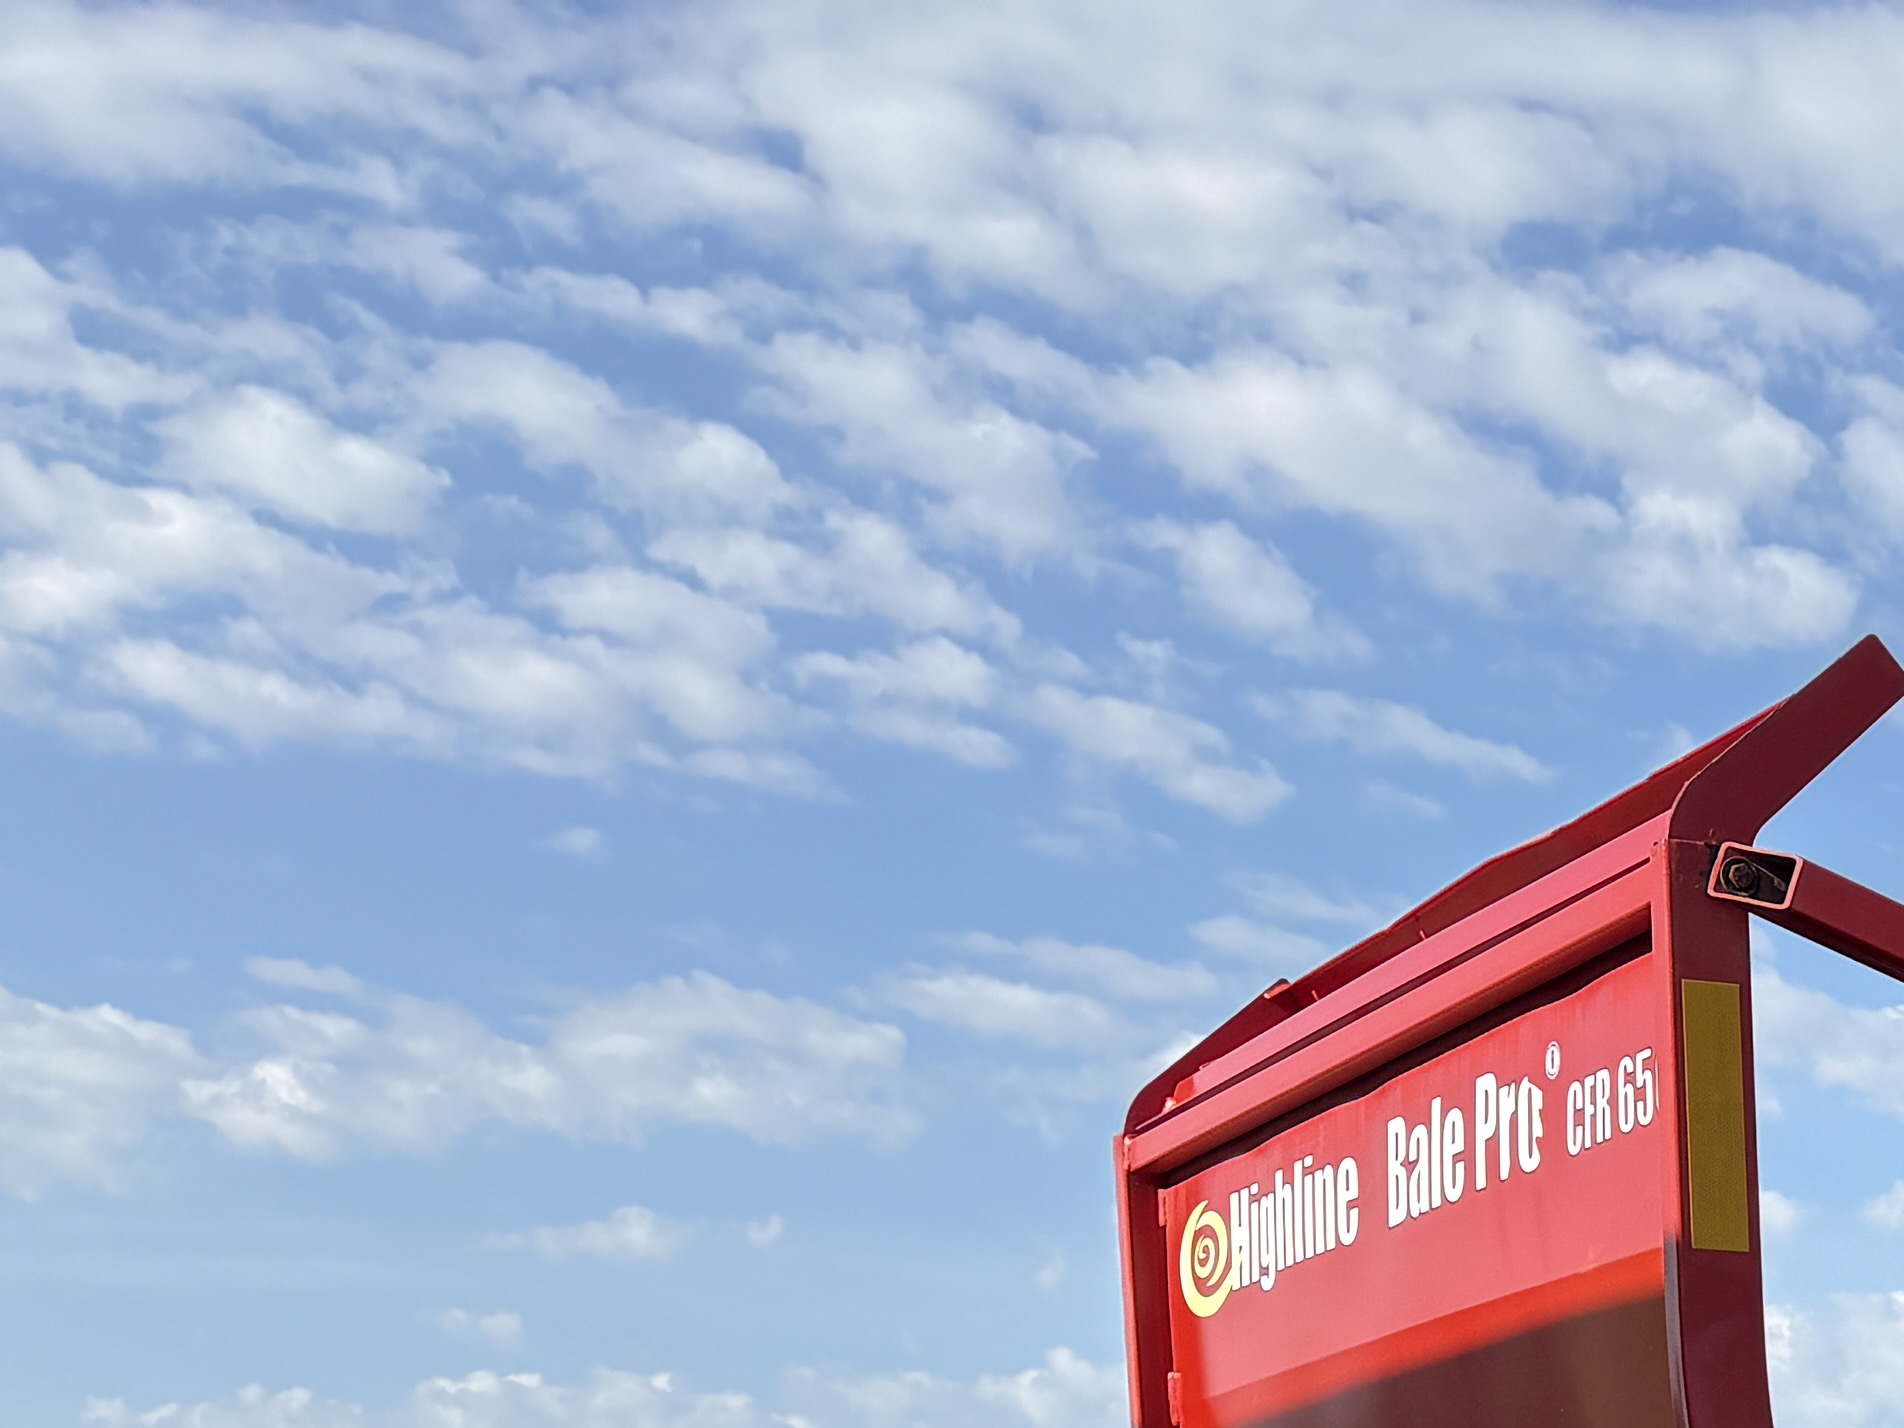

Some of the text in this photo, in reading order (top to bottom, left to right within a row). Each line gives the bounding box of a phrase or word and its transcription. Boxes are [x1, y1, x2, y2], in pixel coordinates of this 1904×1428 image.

[1229, 1154, 1360, 1292] Highline
[1386, 1095, 1466, 1230] Bale
[1475, 1071, 1545, 1192] Pro
[1566, 1067, 1612, 1158] CFR
